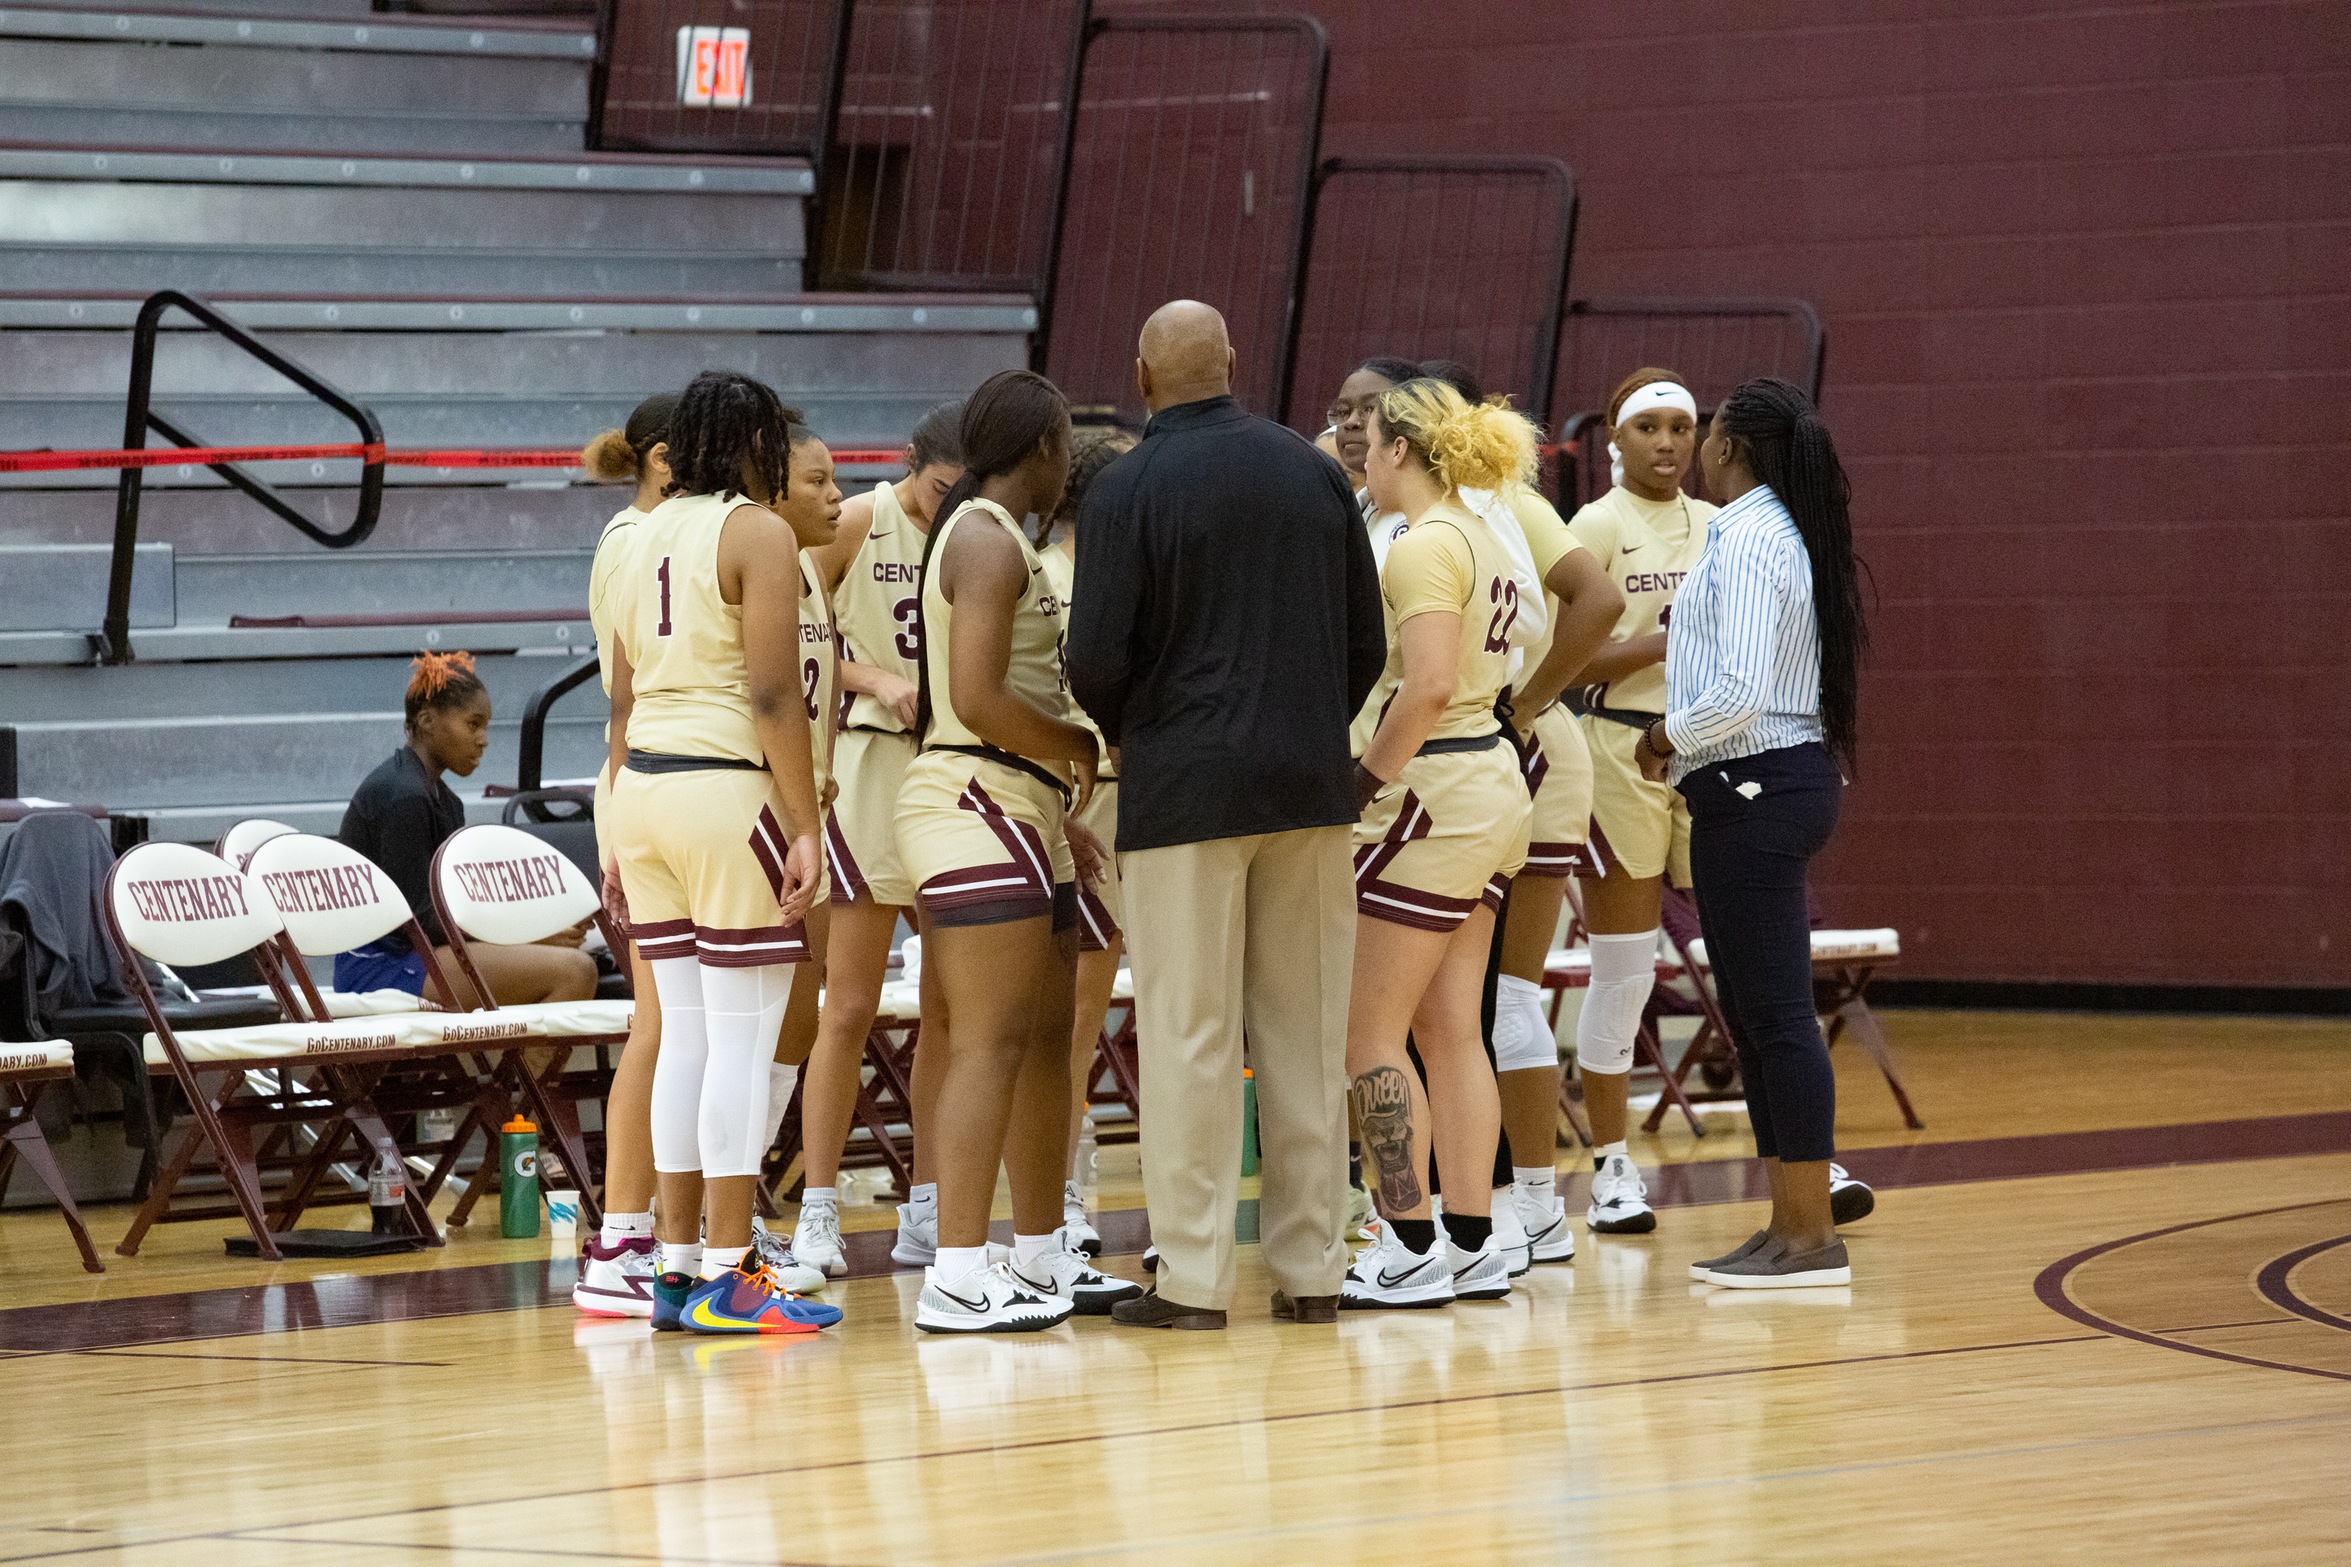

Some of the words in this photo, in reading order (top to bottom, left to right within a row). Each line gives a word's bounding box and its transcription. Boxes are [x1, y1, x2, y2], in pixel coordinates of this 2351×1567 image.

[696, 40, 747, 97] EXIT
[657, 556, 672, 637] 1
[1483, 575, 1519, 656] 22
[893, 597, 919, 661] 3
[803, 657, 820, 722] 2
[127, 875, 249, 922] CENTENARY
[261, 863, 380, 912] CENTENARY
[453, 854, 567, 902] CENTENARY
